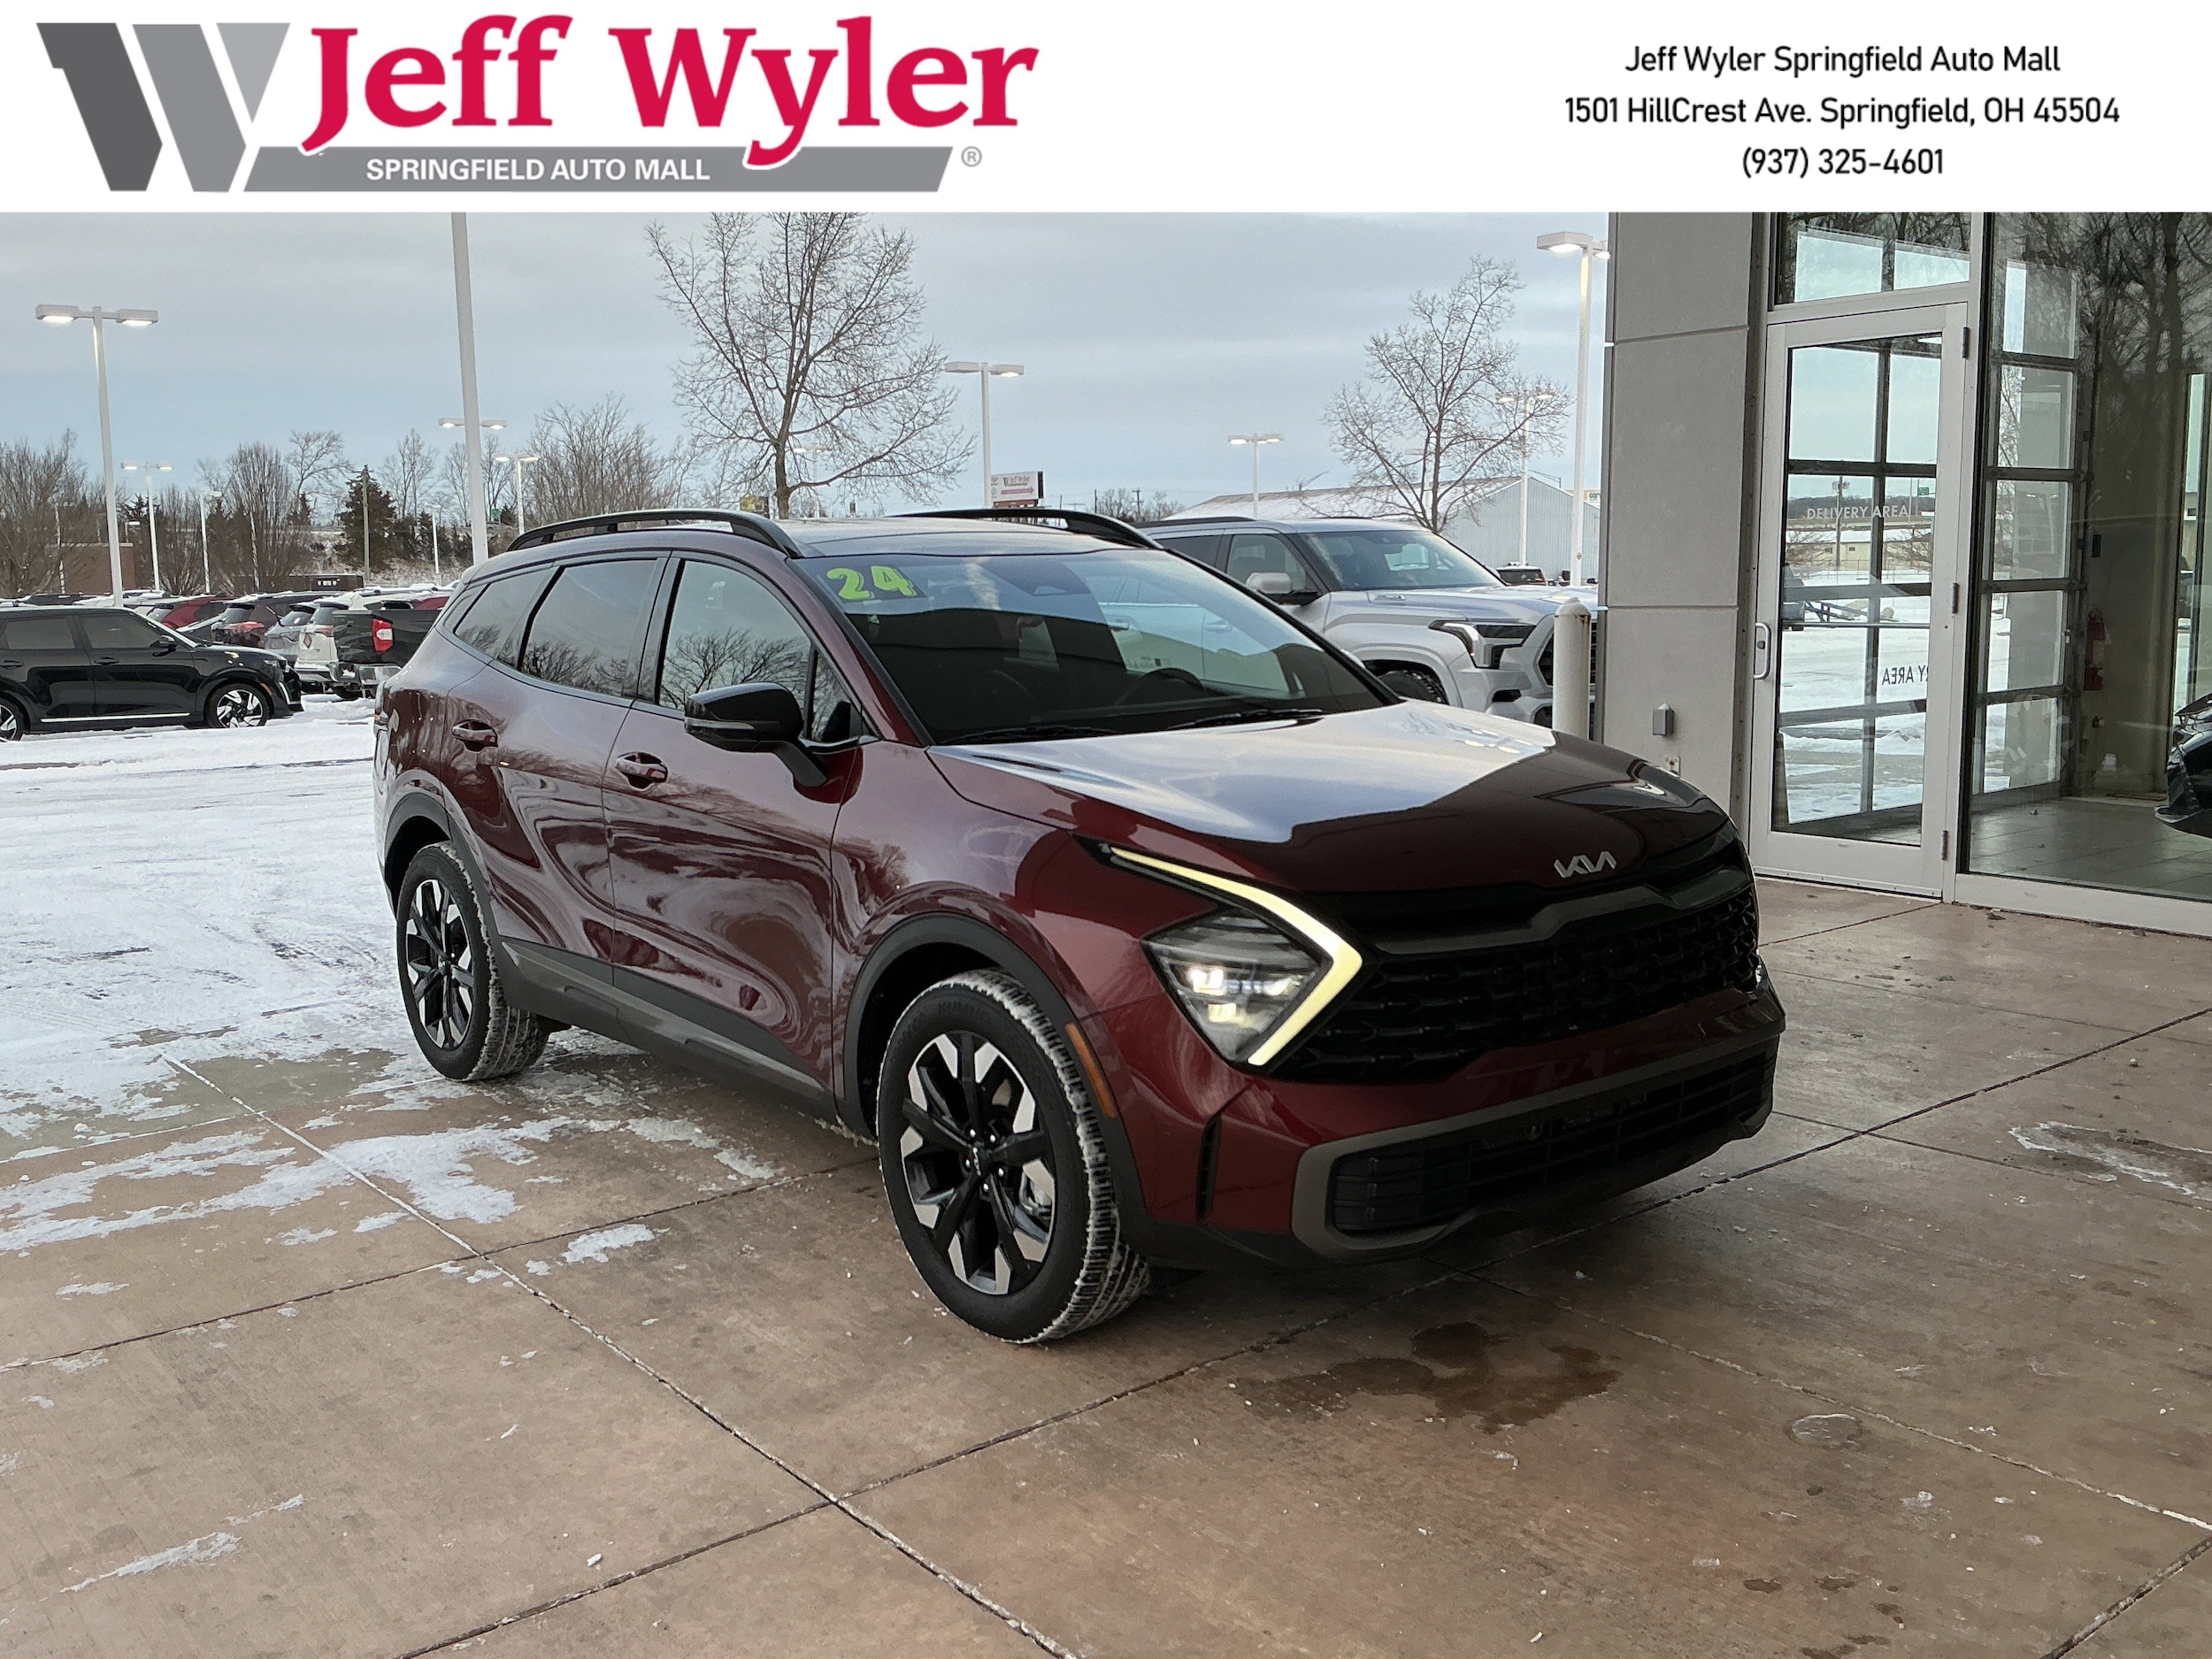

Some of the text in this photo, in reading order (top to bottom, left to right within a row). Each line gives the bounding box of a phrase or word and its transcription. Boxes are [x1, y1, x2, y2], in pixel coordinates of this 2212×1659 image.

[1807, 504, 1909, 520] DELIVERY AREA
[826, 565, 918, 600] 24
[1554, 850, 1617, 879] KIA
